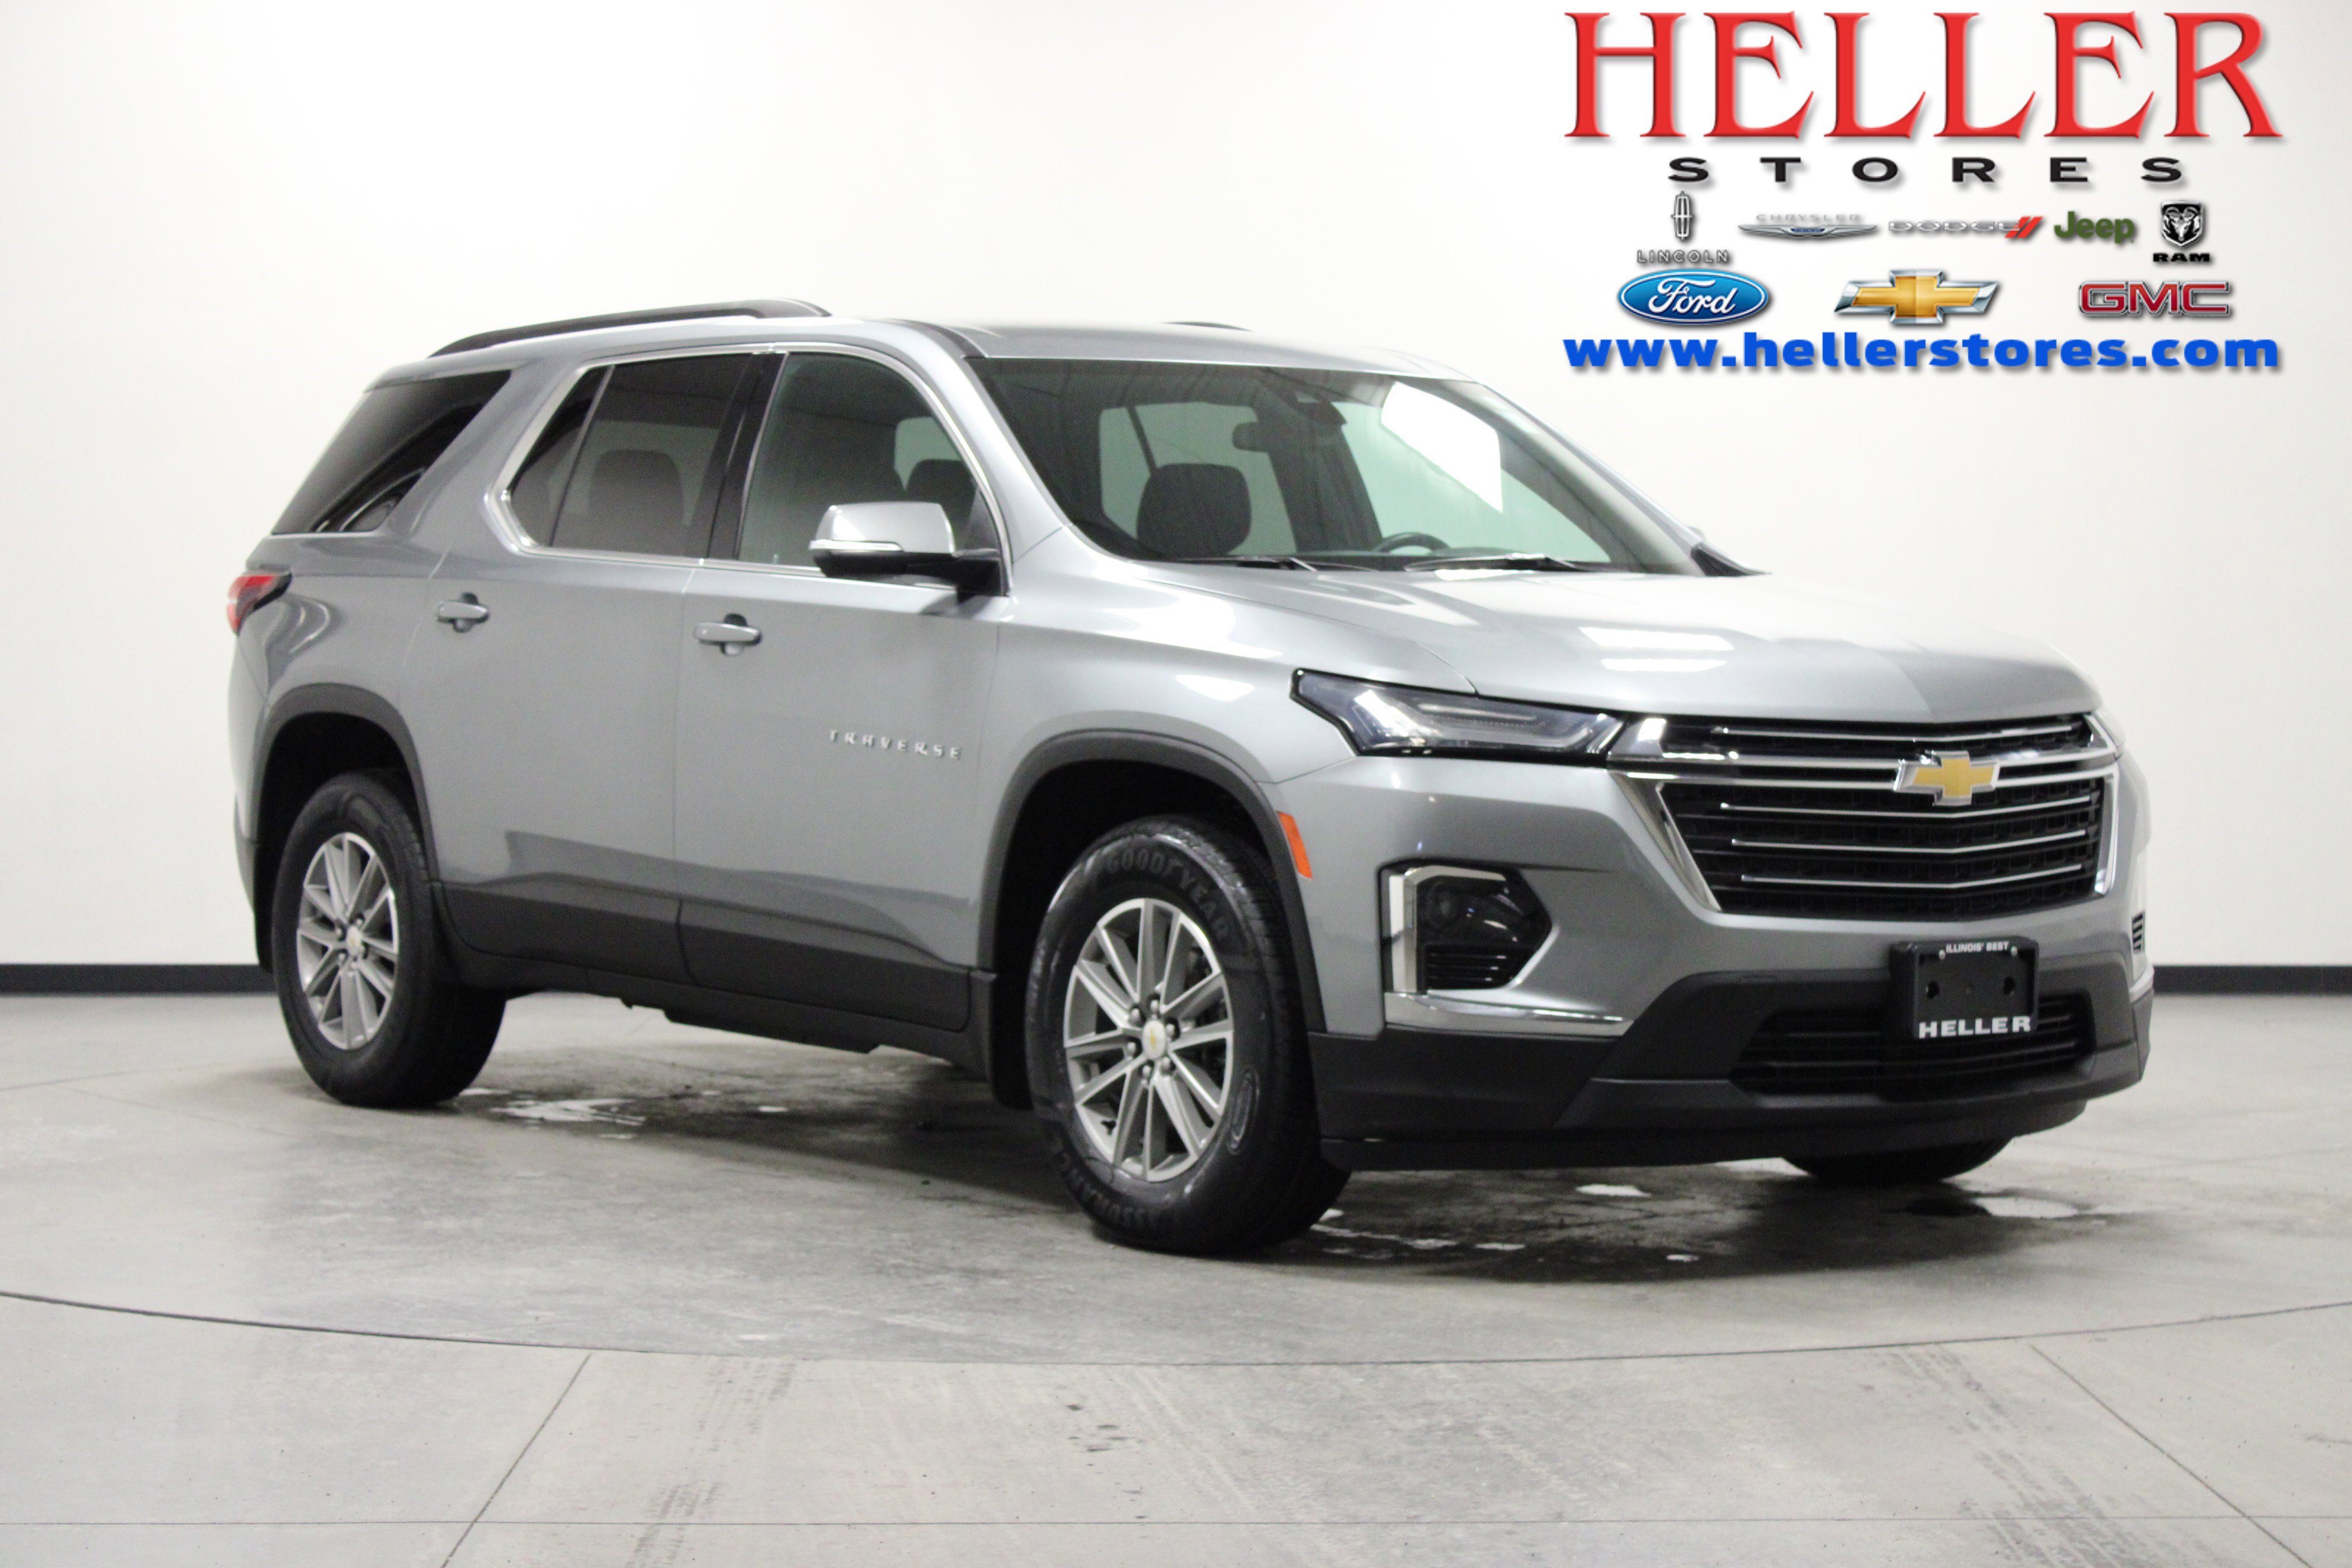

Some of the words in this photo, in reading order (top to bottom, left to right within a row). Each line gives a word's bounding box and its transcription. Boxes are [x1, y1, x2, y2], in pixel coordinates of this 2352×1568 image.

[830, 729, 961, 760] TRAVERSE
[1985, 940, 2010, 952] BEST
[1919, 1015, 2031, 1039] HELLER
